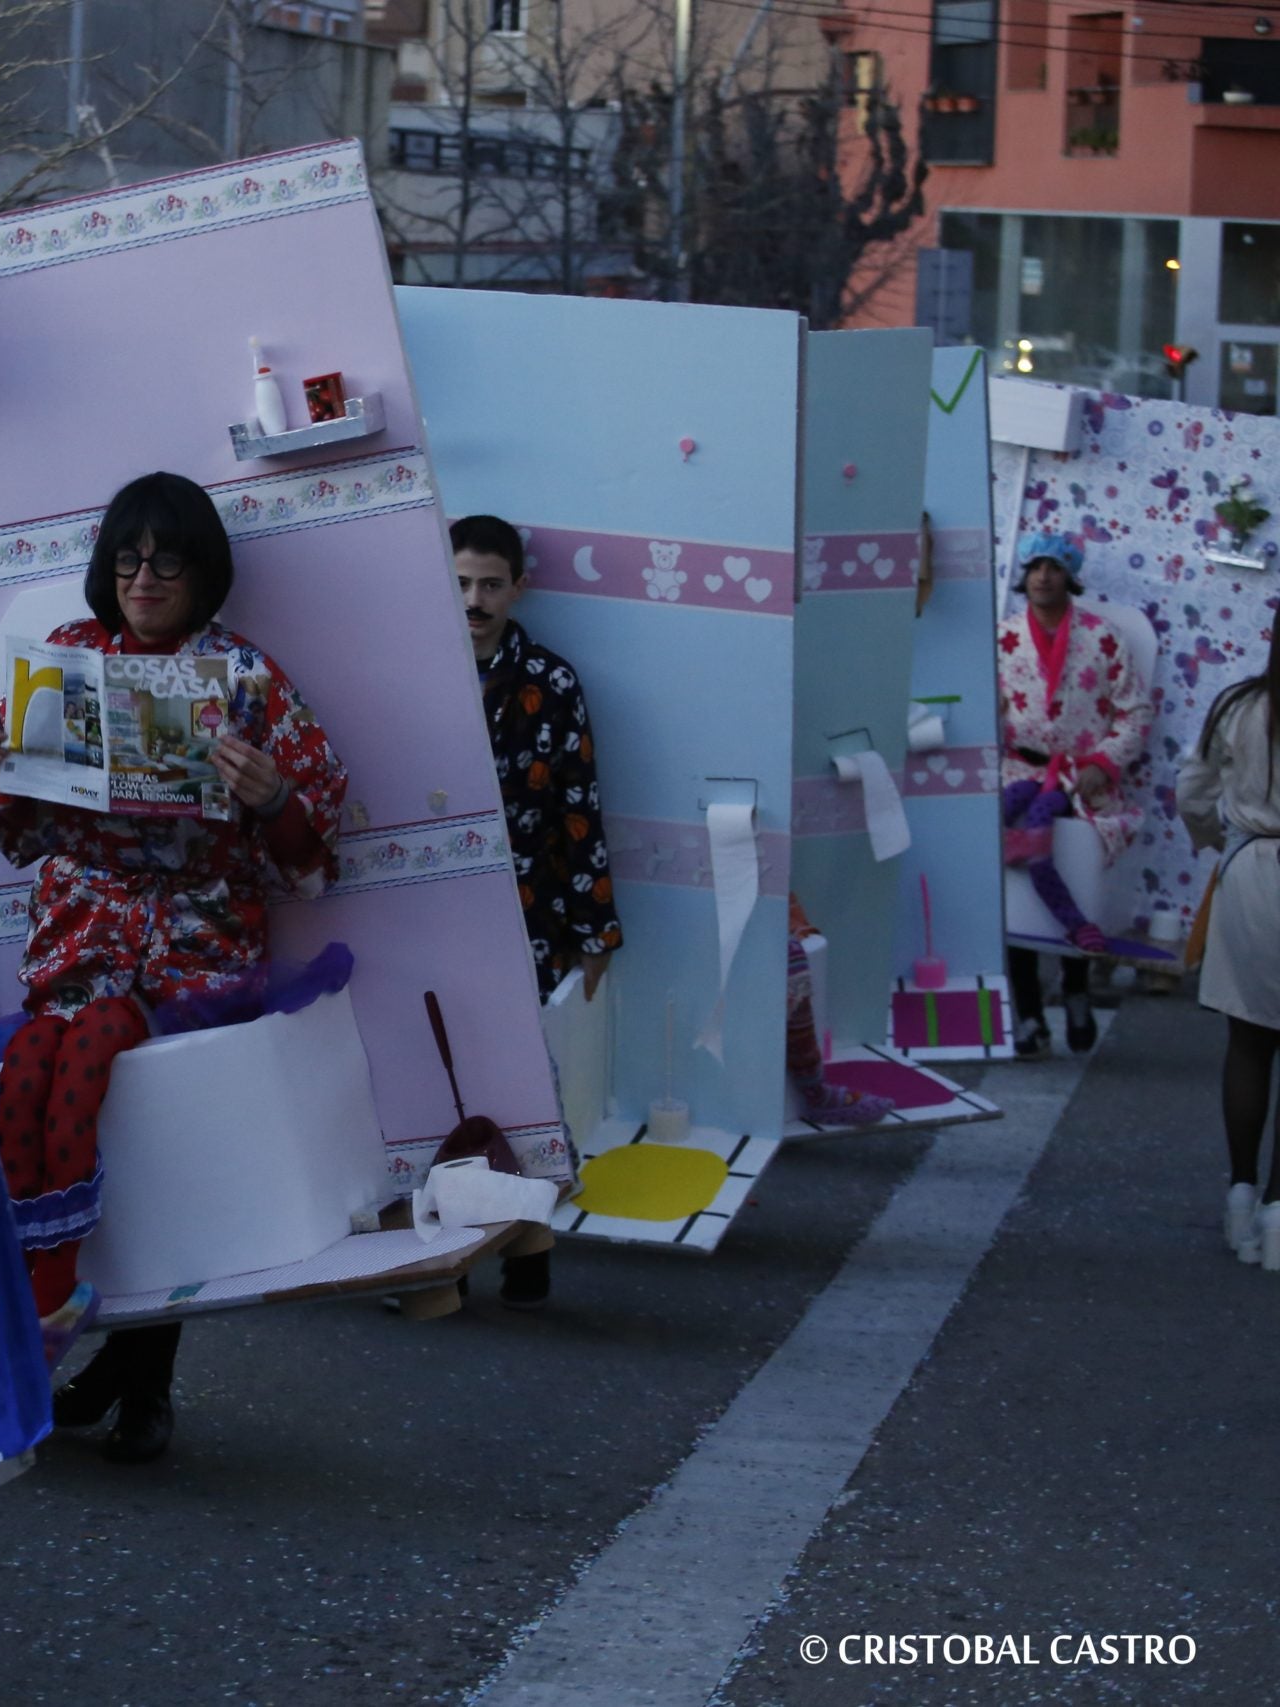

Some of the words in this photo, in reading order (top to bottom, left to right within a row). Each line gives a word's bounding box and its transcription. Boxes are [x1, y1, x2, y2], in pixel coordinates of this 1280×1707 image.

[105, 657, 197, 680] COSAS
[149, 677, 225, 699] CASA
[127, 772, 159, 784] IDEAS
[111, 789, 140, 800] PARA
[142, 792, 195, 803] RENOVAR
